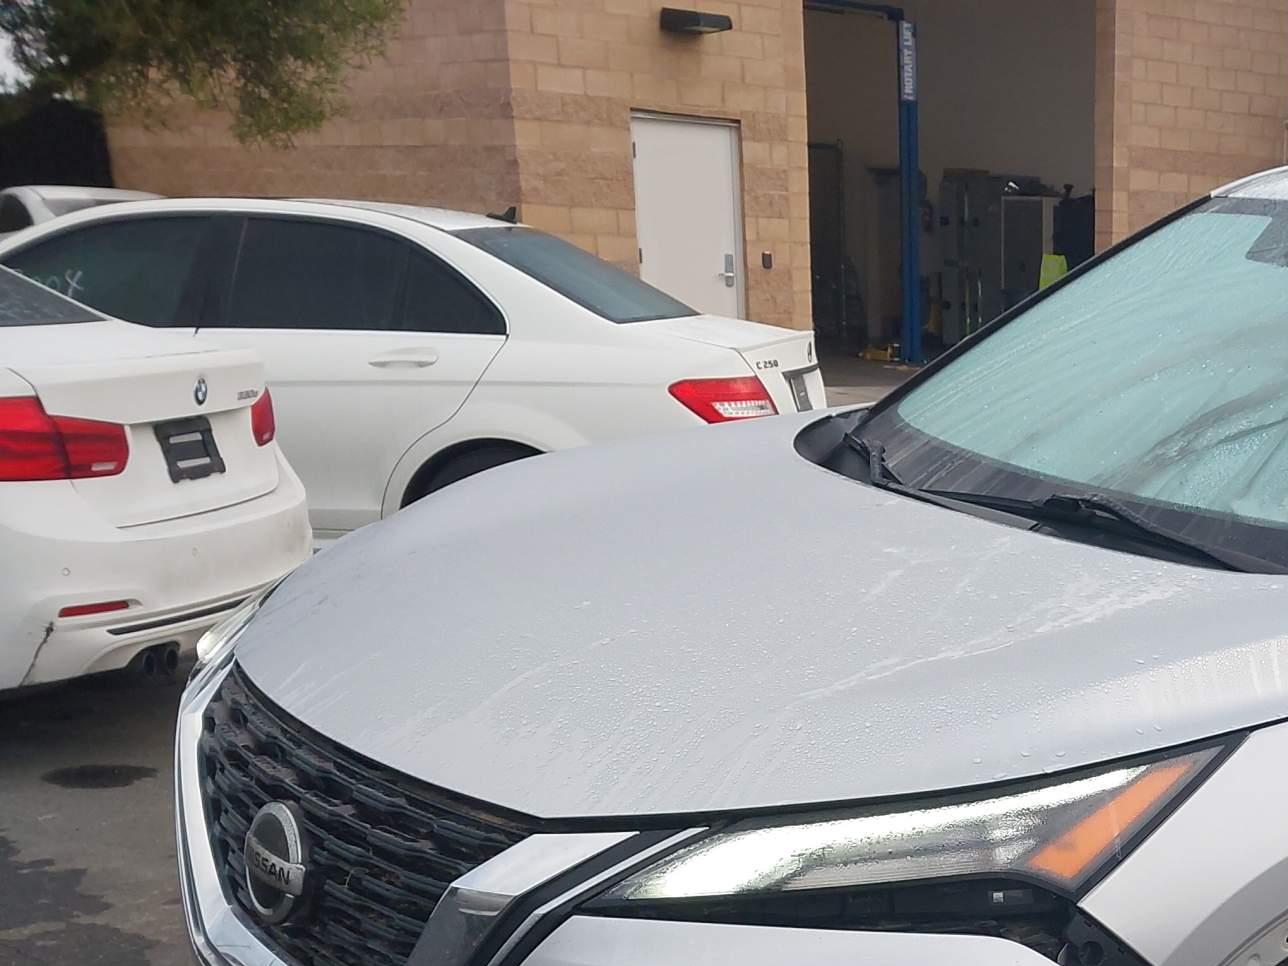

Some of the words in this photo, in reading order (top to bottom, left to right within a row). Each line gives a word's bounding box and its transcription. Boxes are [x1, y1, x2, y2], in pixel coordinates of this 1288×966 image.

[903, 22, 912, 46] LIFT
[756, 361, 762, 370] C
[763, 359, 779, 369] 250
[247, 846, 291, 886] SSAN
